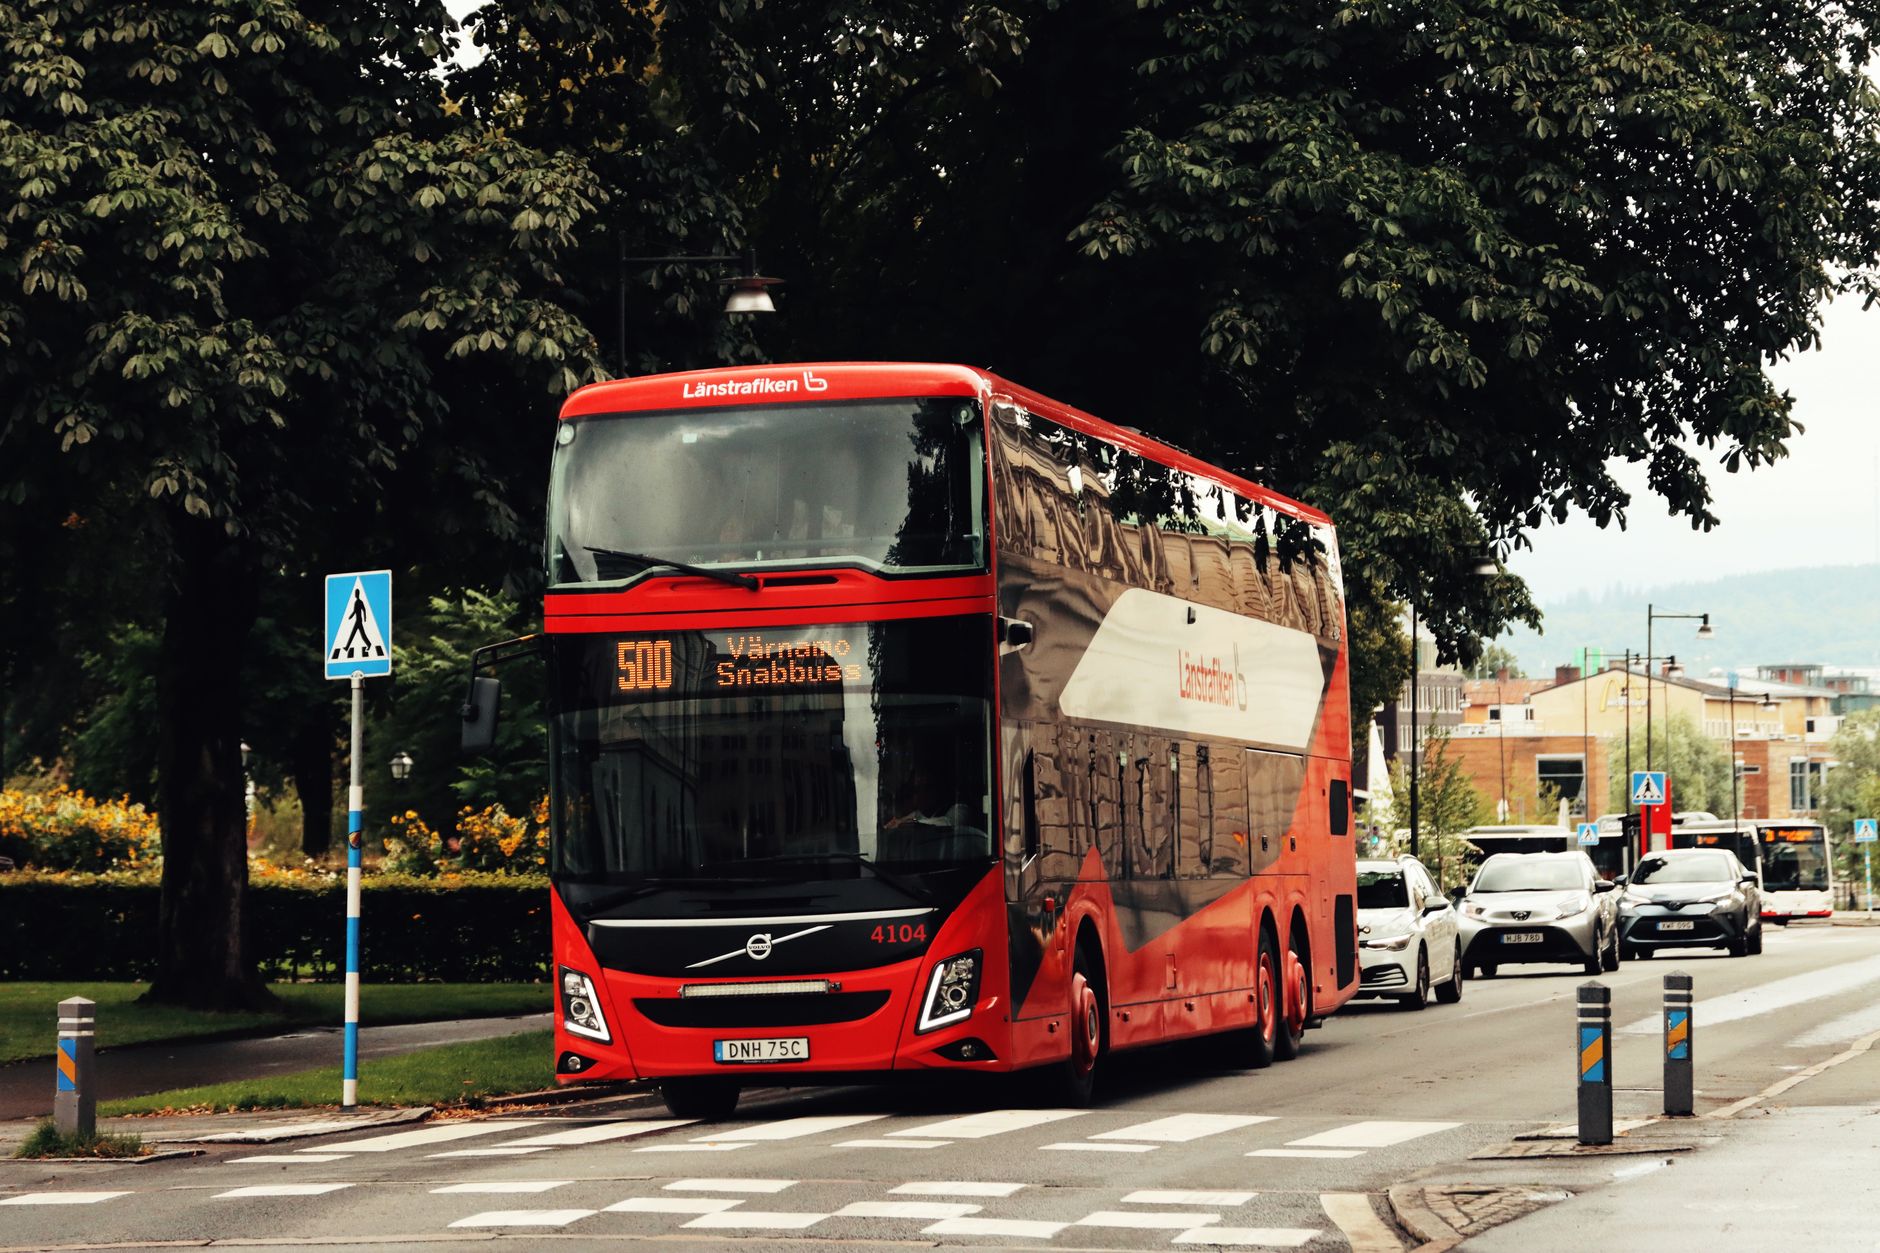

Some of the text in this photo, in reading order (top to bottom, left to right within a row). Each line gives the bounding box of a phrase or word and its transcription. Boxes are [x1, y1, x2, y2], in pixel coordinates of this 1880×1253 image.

[683, 378, 798, 399] Länstrafiken
[727, 636, 850, 660] Värnamo
[617, 640, 672, 690] 500
[717, 660, 862, 686] Snabbuss
[1178, 648, 1234, 708] Länstrafiken
[871, 924, 927, 943] 4104
[729, 1040, 800, 1058] DNH 75C
